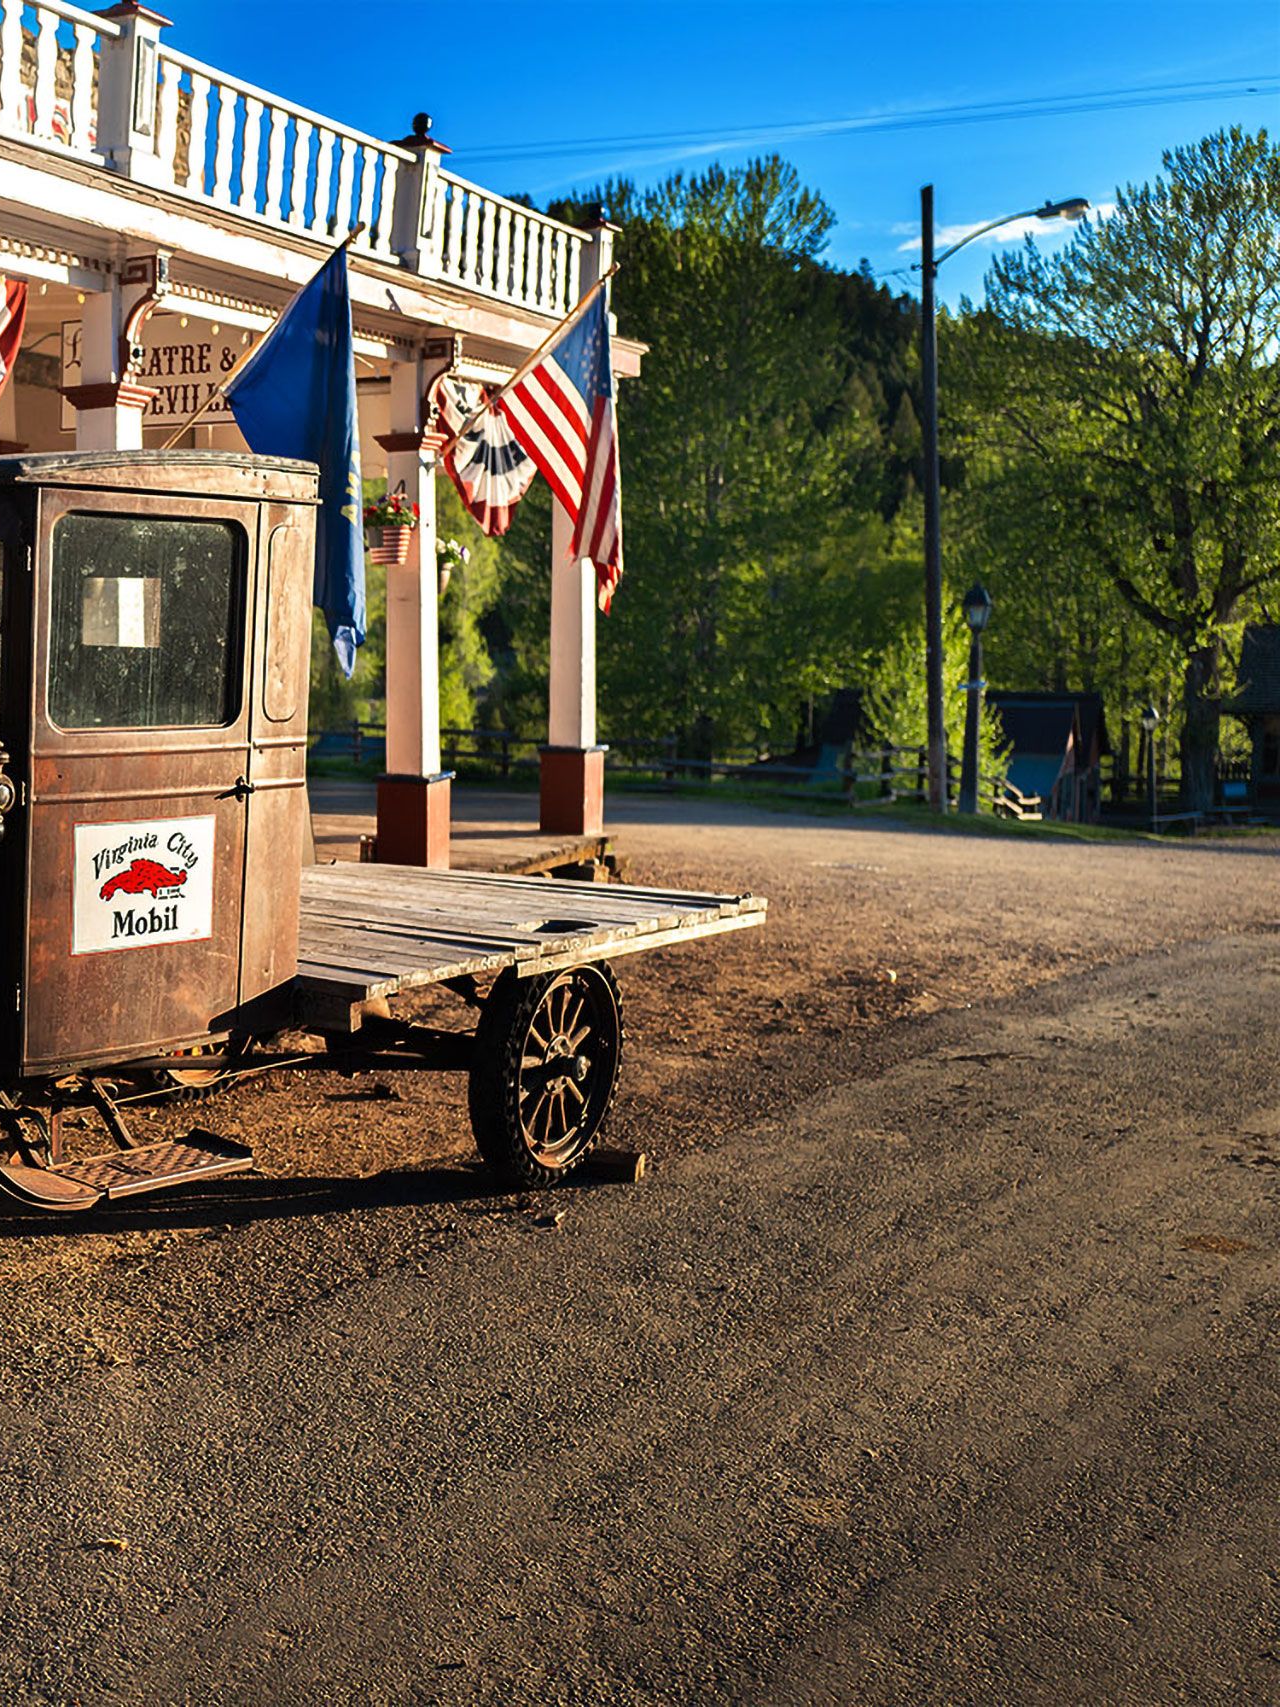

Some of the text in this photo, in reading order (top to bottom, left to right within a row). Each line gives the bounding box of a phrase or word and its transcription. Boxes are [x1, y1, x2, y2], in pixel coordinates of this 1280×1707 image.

[92, 832, 199, 880] Virginia City
[111, 905, 179, 938] Mobil
